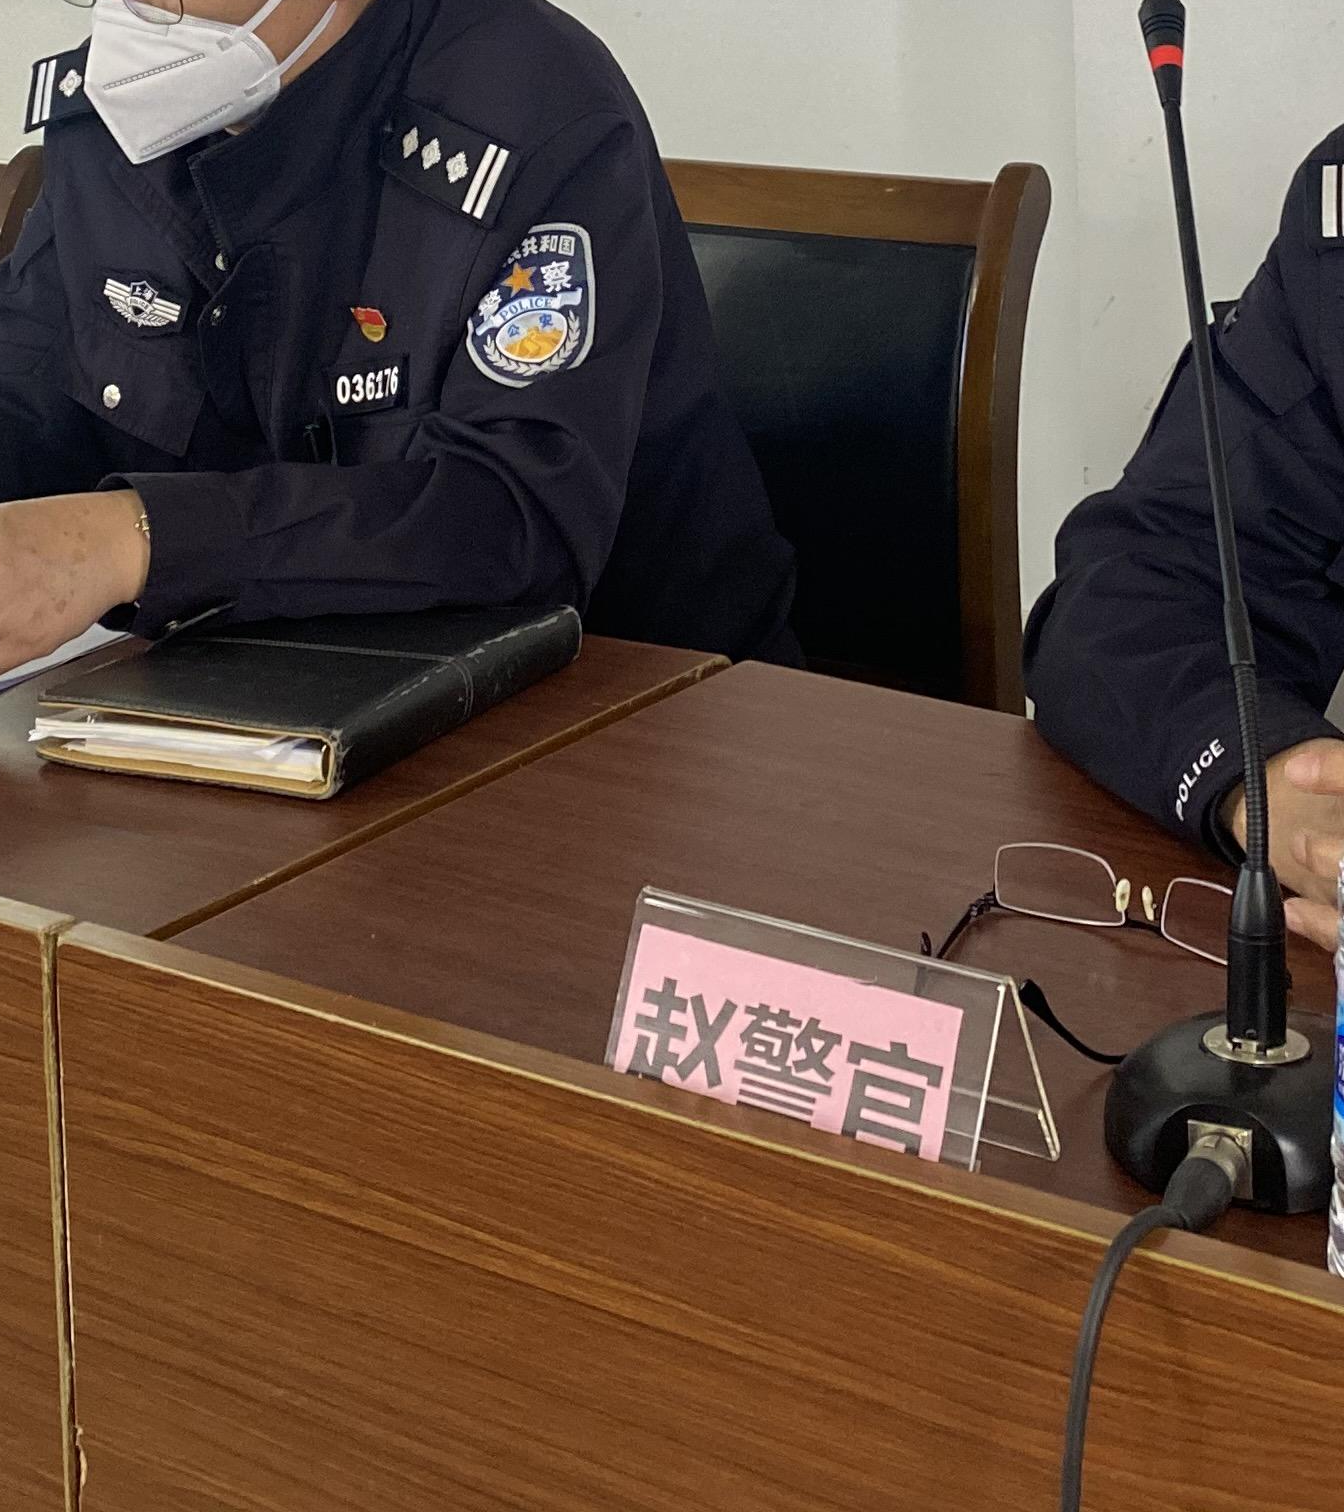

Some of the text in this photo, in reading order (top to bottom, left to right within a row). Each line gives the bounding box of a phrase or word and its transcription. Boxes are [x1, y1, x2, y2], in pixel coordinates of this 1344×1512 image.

[499, 298, 553, 321] POLICE
[336, 366, 399, 405] 036176
[1175, 738, 1225, 822] POLICE
[627, 976, 944, 1156] 赵警官
